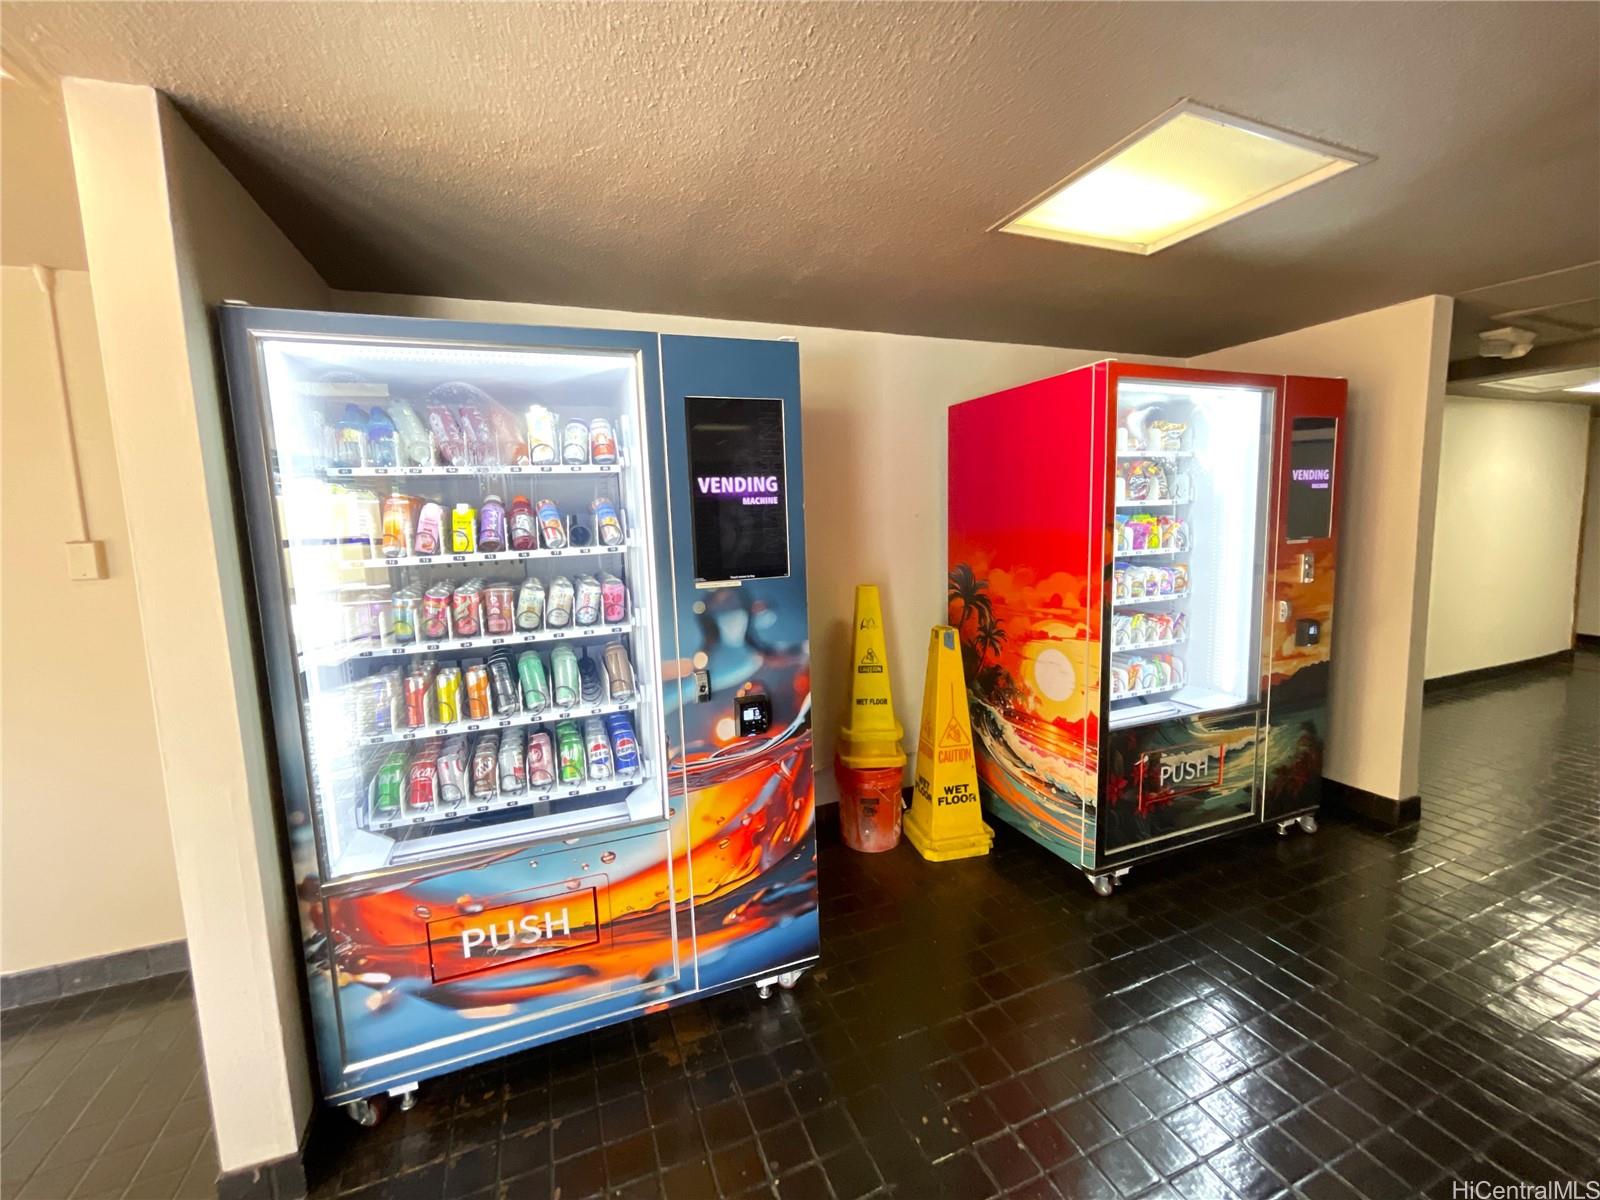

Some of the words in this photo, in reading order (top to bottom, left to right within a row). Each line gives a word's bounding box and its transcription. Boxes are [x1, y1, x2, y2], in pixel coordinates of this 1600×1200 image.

[1292, 469, 1329, 481] VENDING
[697, 476, 778, 494] VENDING
[742, 496, 778, 505] MACHINE
[938, 748, 972, 763] CAUTION
[1160, 756, 1209, 786] PUSH
[944, 784, 969, 795] WET
[937, 793, 977, 807] FLOOR
[462, 907, 570, 959] PUSH
